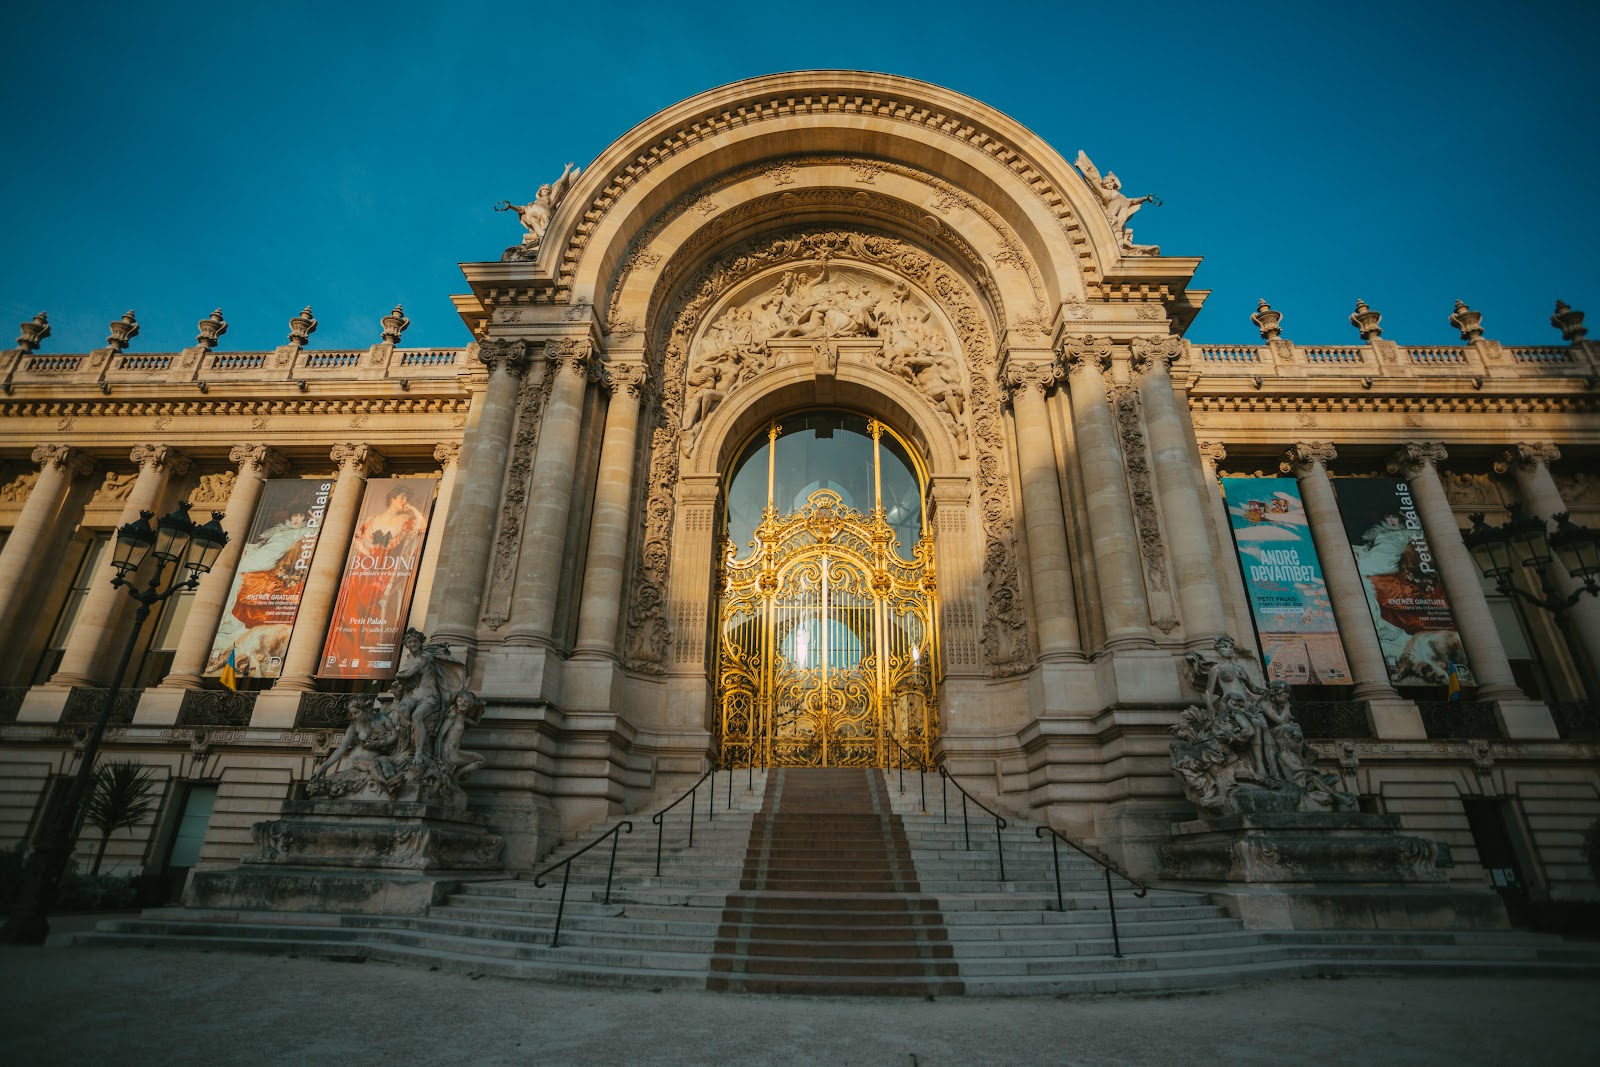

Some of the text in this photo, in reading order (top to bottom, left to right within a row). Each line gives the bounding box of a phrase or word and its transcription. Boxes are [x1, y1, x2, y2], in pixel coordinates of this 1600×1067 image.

[295, 482, 331, 570] Petit Palais
[1395, 483, 1436, 574] Petit Palais
[350, 555, 416, 570] BOLDINI
[367, 617, 387, 625] Palais
